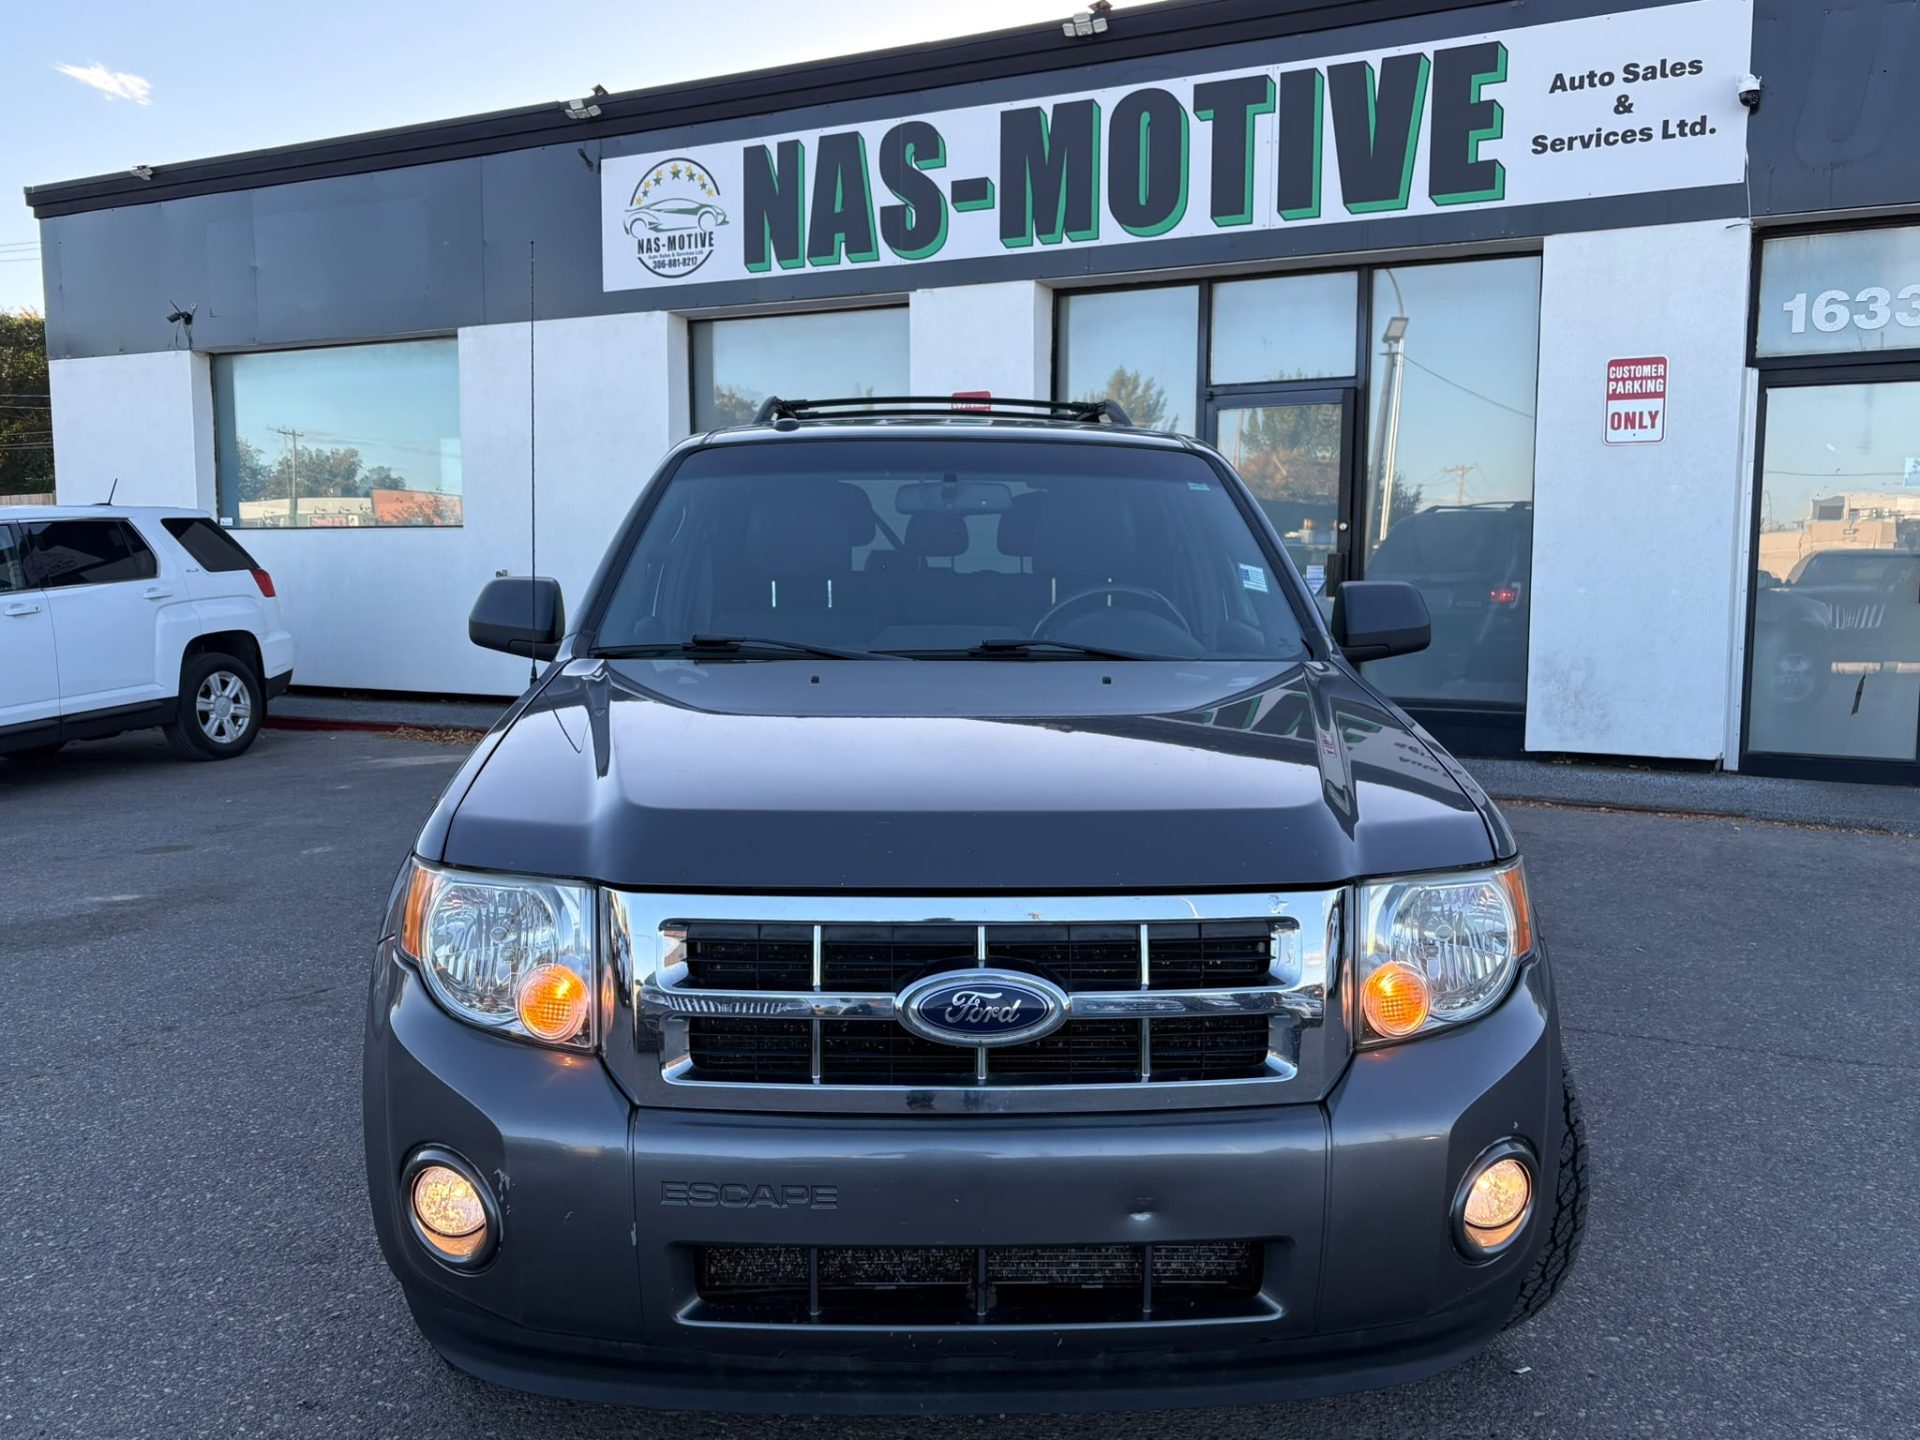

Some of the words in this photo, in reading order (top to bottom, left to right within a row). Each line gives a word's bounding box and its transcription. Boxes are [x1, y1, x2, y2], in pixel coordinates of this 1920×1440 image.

[1549, 70, 1615, 94] Auto
[1622, 58, 1703, 83] Sales
[1613, 94, 1634, 115] &
[1531, 128, 1653, 155] Services
[1661, 115, 1717, 140] Ltd.
[743, 41, 1508, 273] NAS-MOTIVE
[637, 231, 714, 255] NAS-MOTIVE
[1783, 284, 1920, 333] 1633
[1609, 364, 1664, 379] CUSTOMER
[1608, 379, 1664, 395] PARKING
[1610, 410, 1659, 431] ONLY
[945, 990, 1021, 1024] Ford
[660, 1181, 837, 1210] ESCAPE
